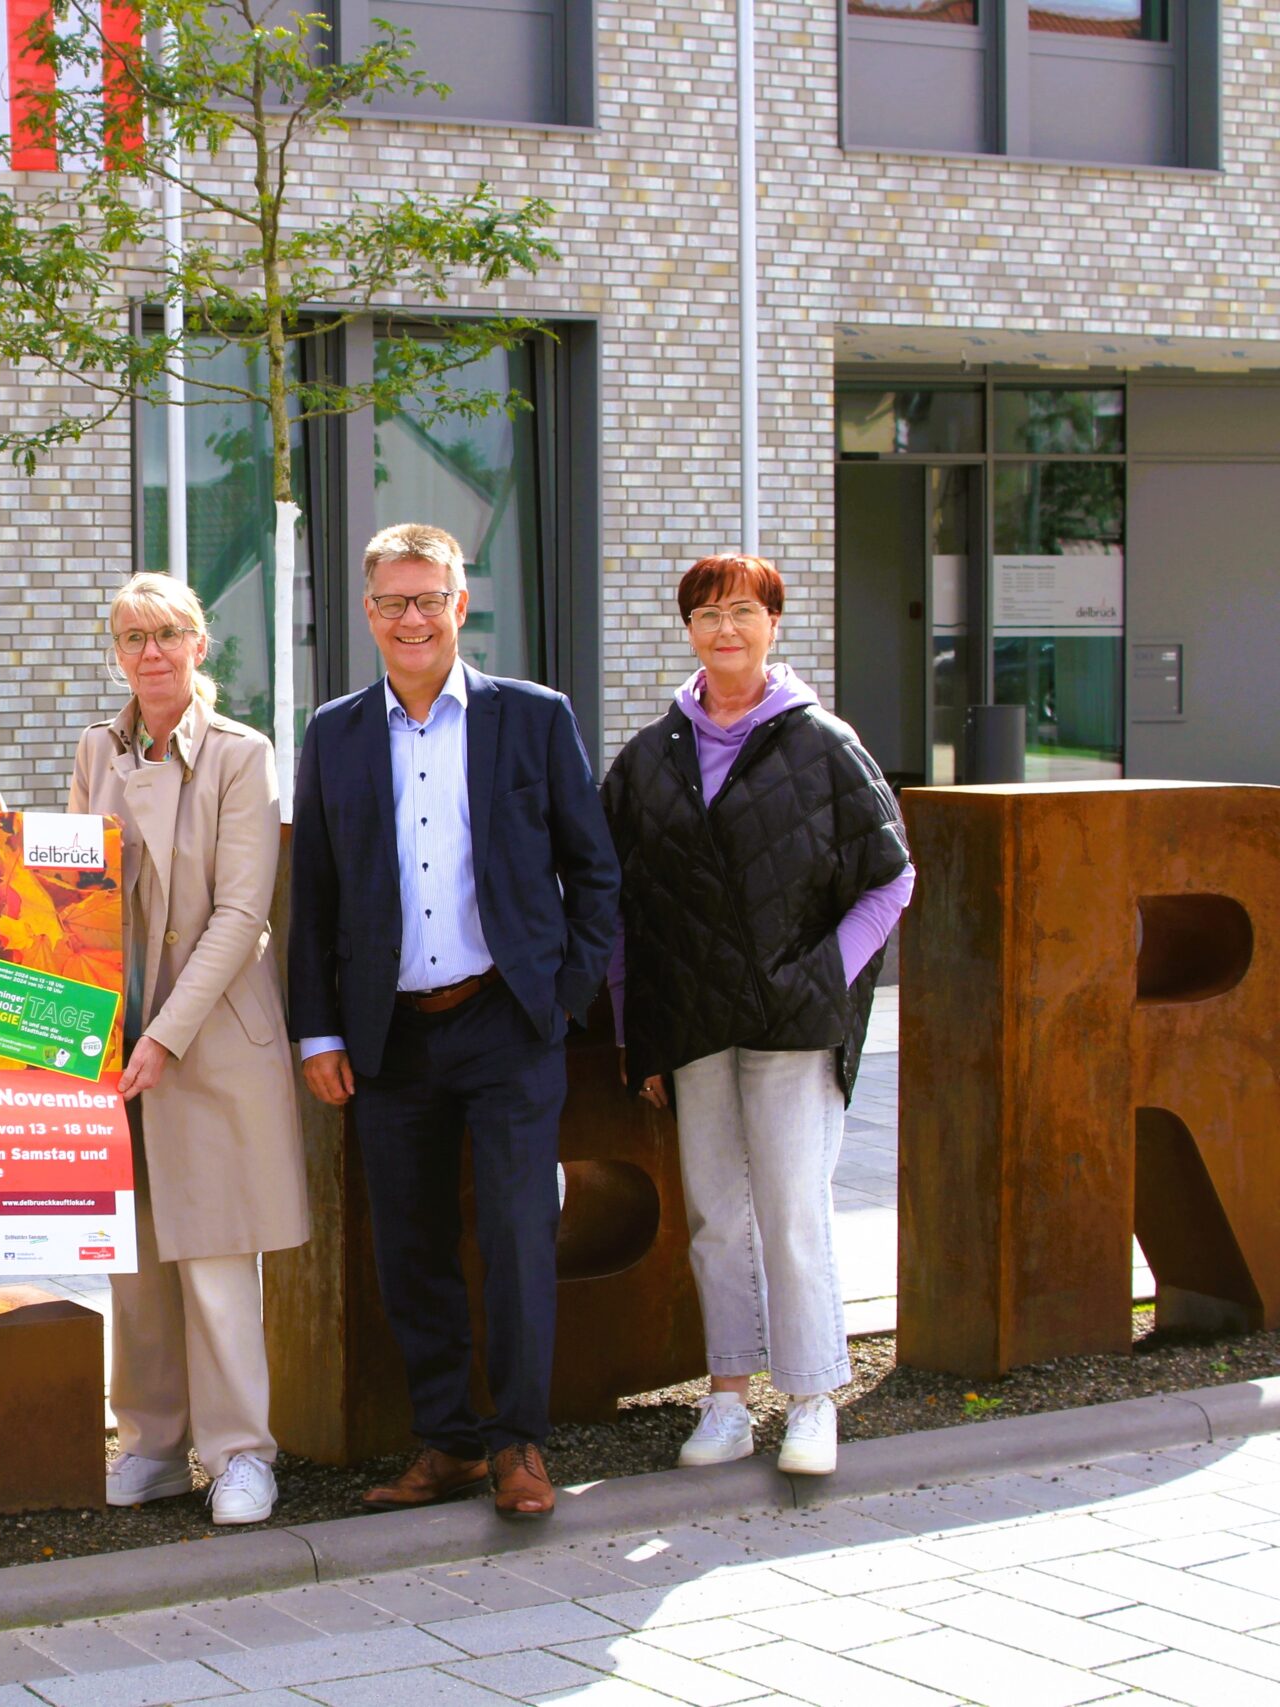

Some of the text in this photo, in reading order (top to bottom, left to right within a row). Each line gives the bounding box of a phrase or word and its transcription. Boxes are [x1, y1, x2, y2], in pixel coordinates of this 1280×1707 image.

[28, 845, 99, 864] delbrück
[13, 977, 27, 985] 2024
[15, 971, 29, 979] 2024
[29, 995, 95, 1034] TAGE
[21, 1025, 49, 1038] Stadthalle
[50, 1033, 74, 1045] Delbrück
[28, 1124, 47, 1135] 13
[63, 1124, 81, 1135] 18
[86, 1124, 113, 1136] Uhr
[11, 1148, 75, 1163] Samstag
[80, 1148, 107, 1161] und
[2, 1199, 95, 1207] www.delbrueckkauftlokal.de
